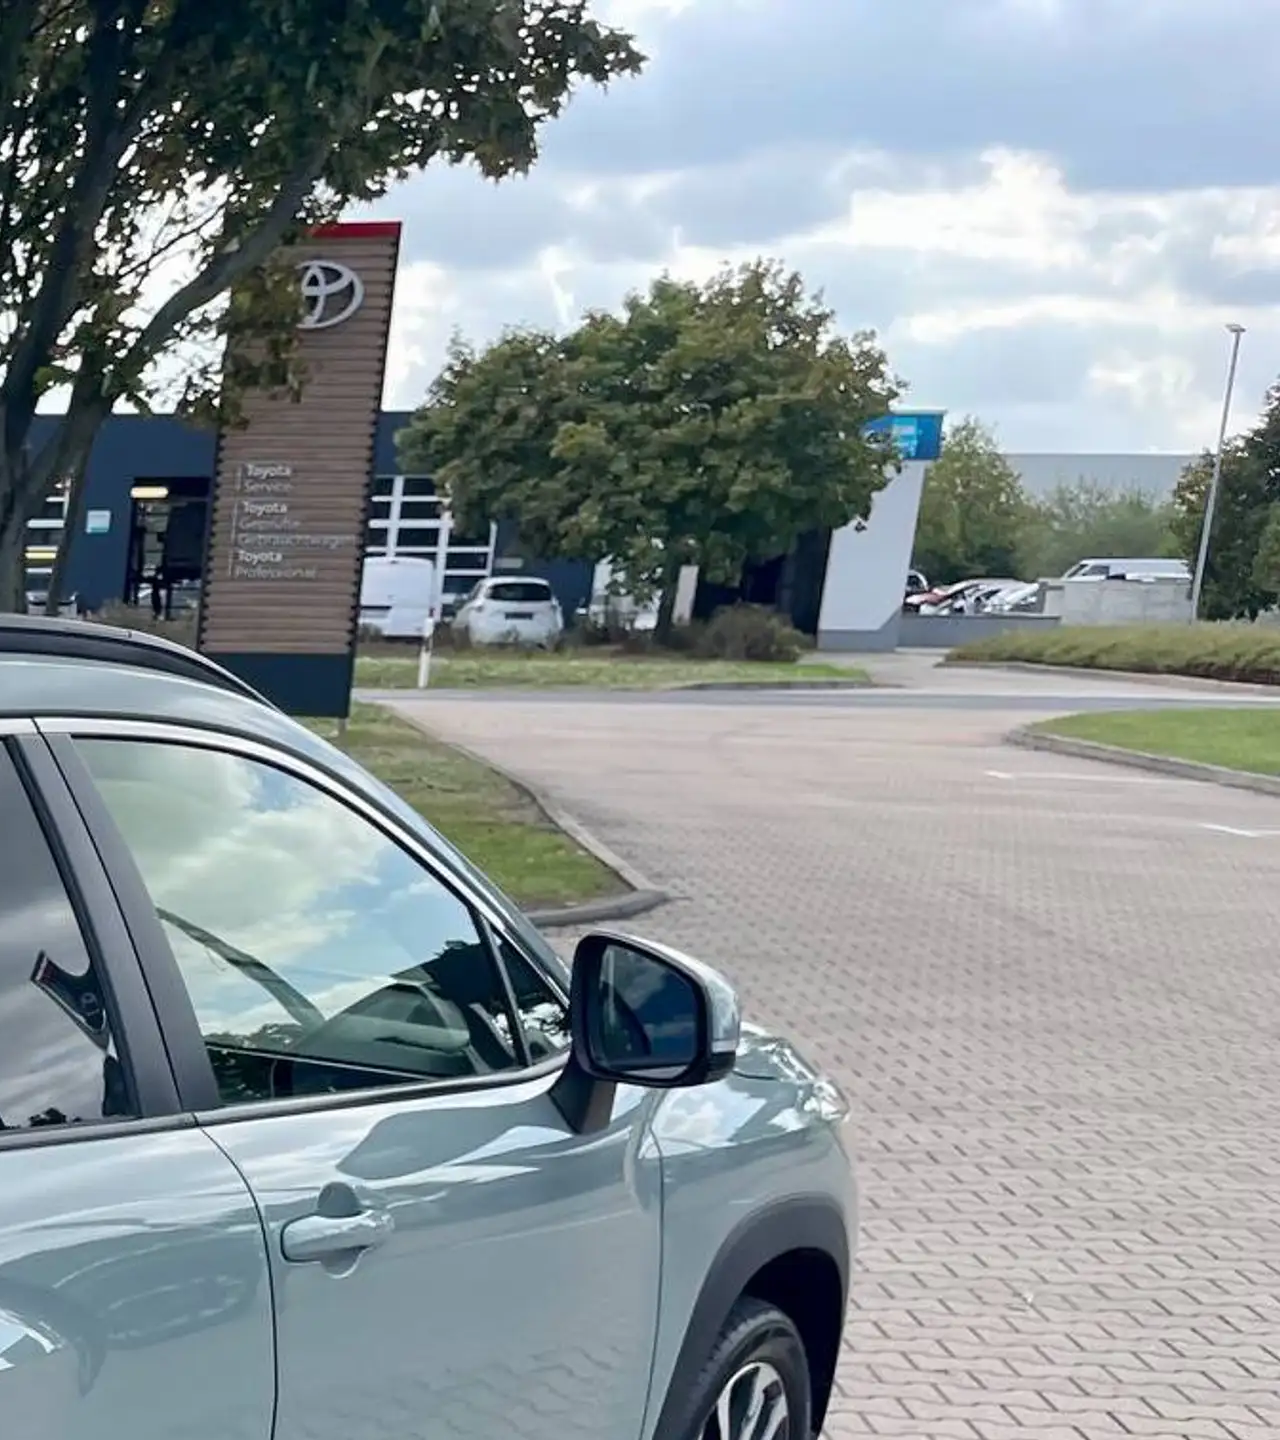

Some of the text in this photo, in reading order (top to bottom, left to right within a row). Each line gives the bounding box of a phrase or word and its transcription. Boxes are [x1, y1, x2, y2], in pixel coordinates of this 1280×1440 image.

[247, 464, 292, 479] Toyota
[242, 501, 288, 517] Toyota
[238, 550, 283, 565] Toyota
